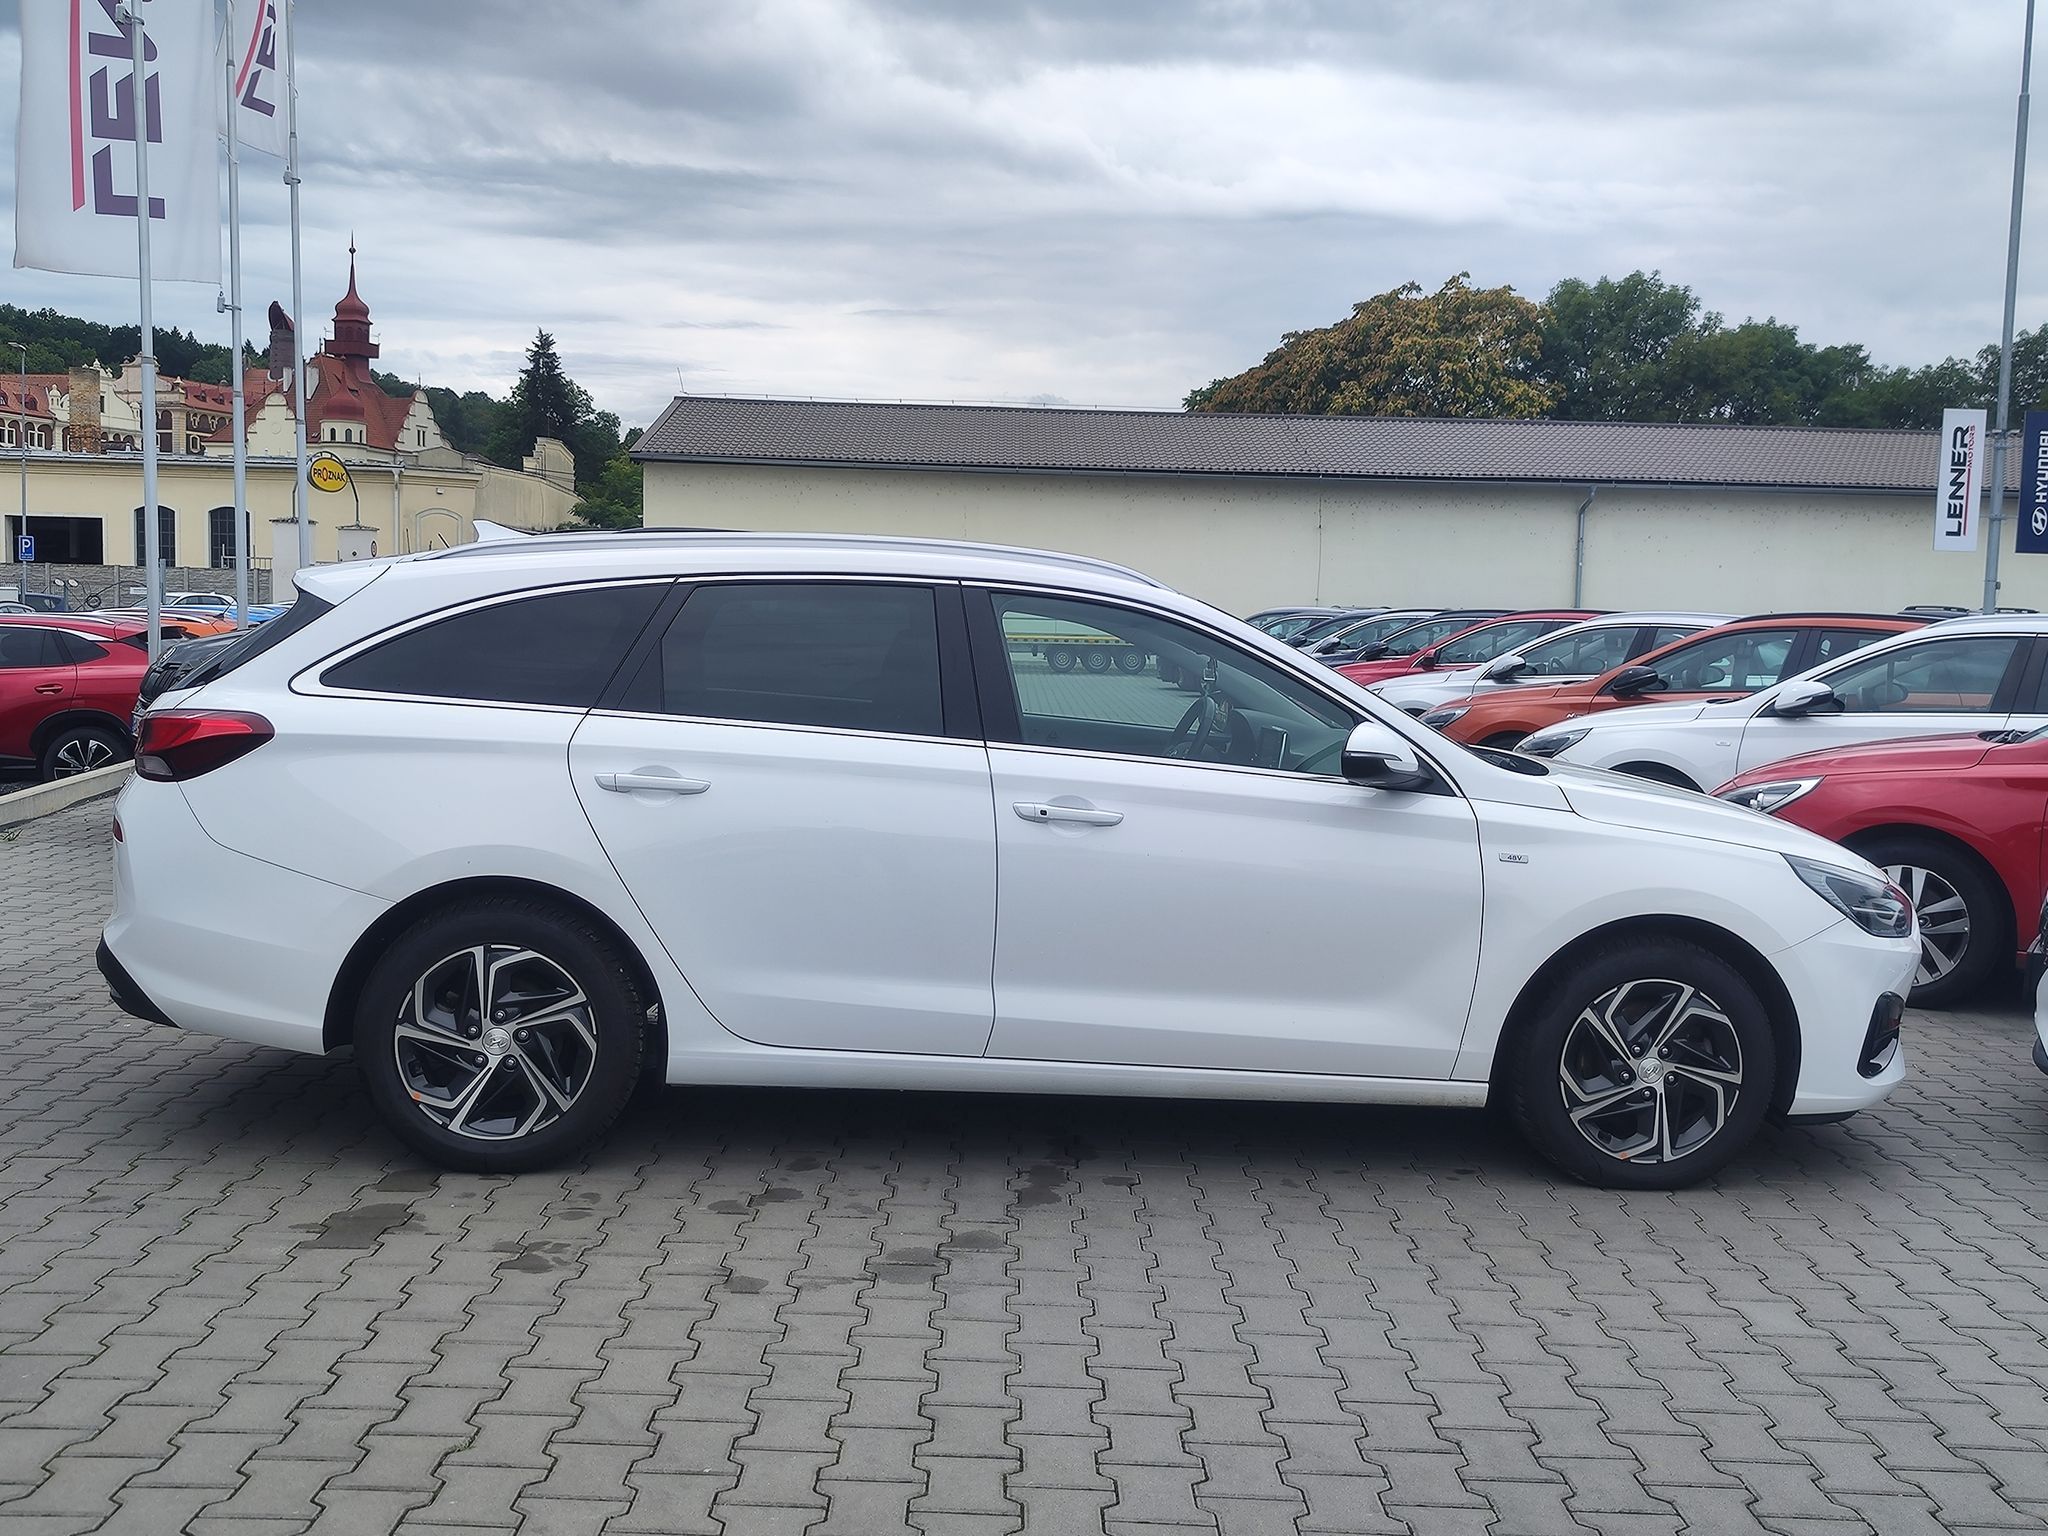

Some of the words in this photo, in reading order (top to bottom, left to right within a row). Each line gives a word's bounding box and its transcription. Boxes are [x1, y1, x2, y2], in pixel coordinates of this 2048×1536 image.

[313, 467, 346, 482] PROZNAK
[1945, 425, 1971, 537] LENNER
[22, 539, 31, 553] P
